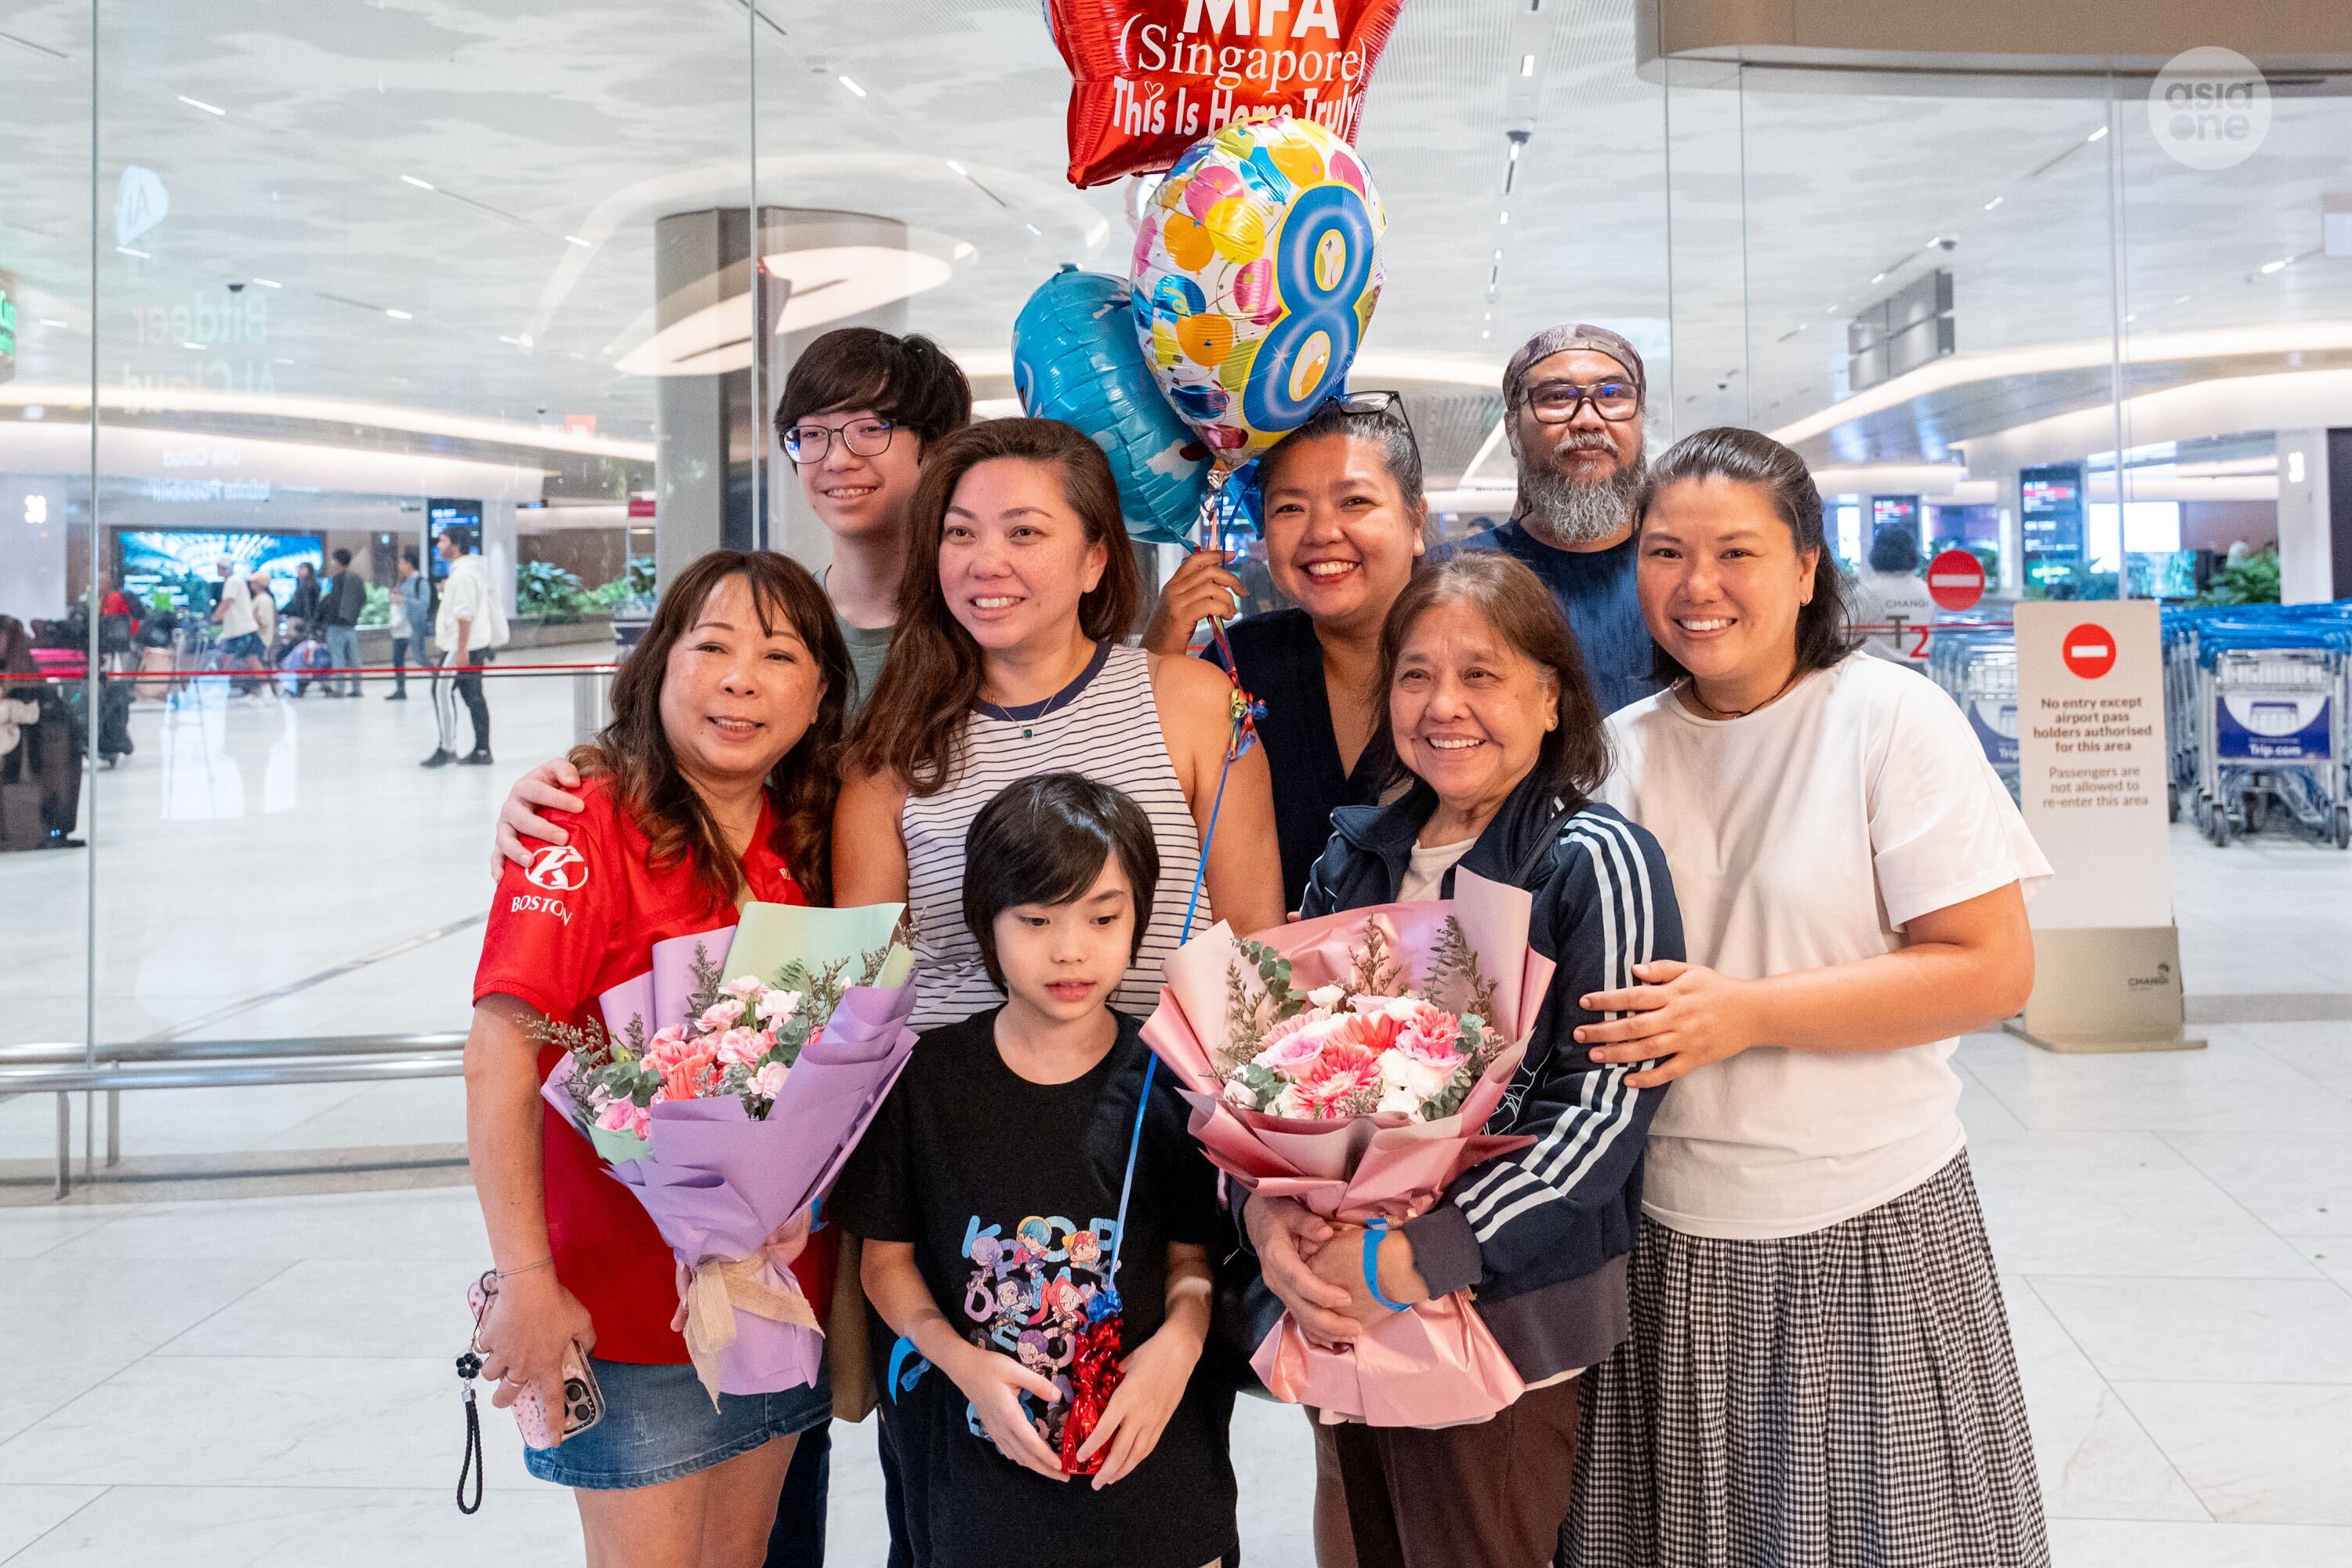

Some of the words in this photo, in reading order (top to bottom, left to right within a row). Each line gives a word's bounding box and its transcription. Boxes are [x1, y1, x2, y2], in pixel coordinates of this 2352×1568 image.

[1182, 0, 1340, 38] MFA
[1120, 13, 1366, 93] (Singapore)
[1113, 76, 1166, 136] This
[1174, 87, 1200, 136] Is
[1241, 180, 1376, 433] 8
[2041, 698, 2059, 709] No
[2062, 699, 2096, 710] entry
[2100, 697, 2142, 710] except
[2055, 712, 2099, 724] airport
[2102, 713, 2130, 724] pass
[2033, 727, 2081, 738] holders
[2084, 725, 2152, 737] authorised
[2055, 741, 2074, 752] for
[2078, 741, 2100, 752] this
[2103, 742, 2132, 751] area
[2249, 743, 2302, 758] Trip.com
[2049, 767, 2117, 779] Passengers
[2121, 768, 2140, 776] are
[2051, 782, 2071, 793] not
[2075, 781, 2122, 792] allowed
[2126, 781, 2139, 791] to
[2042, 797, 2092, 808] re-enter
[2096, 795, 2118, 806] this
[2122, 796, 2148, 806] area
[510, 895, 572, 927] BOSTON
